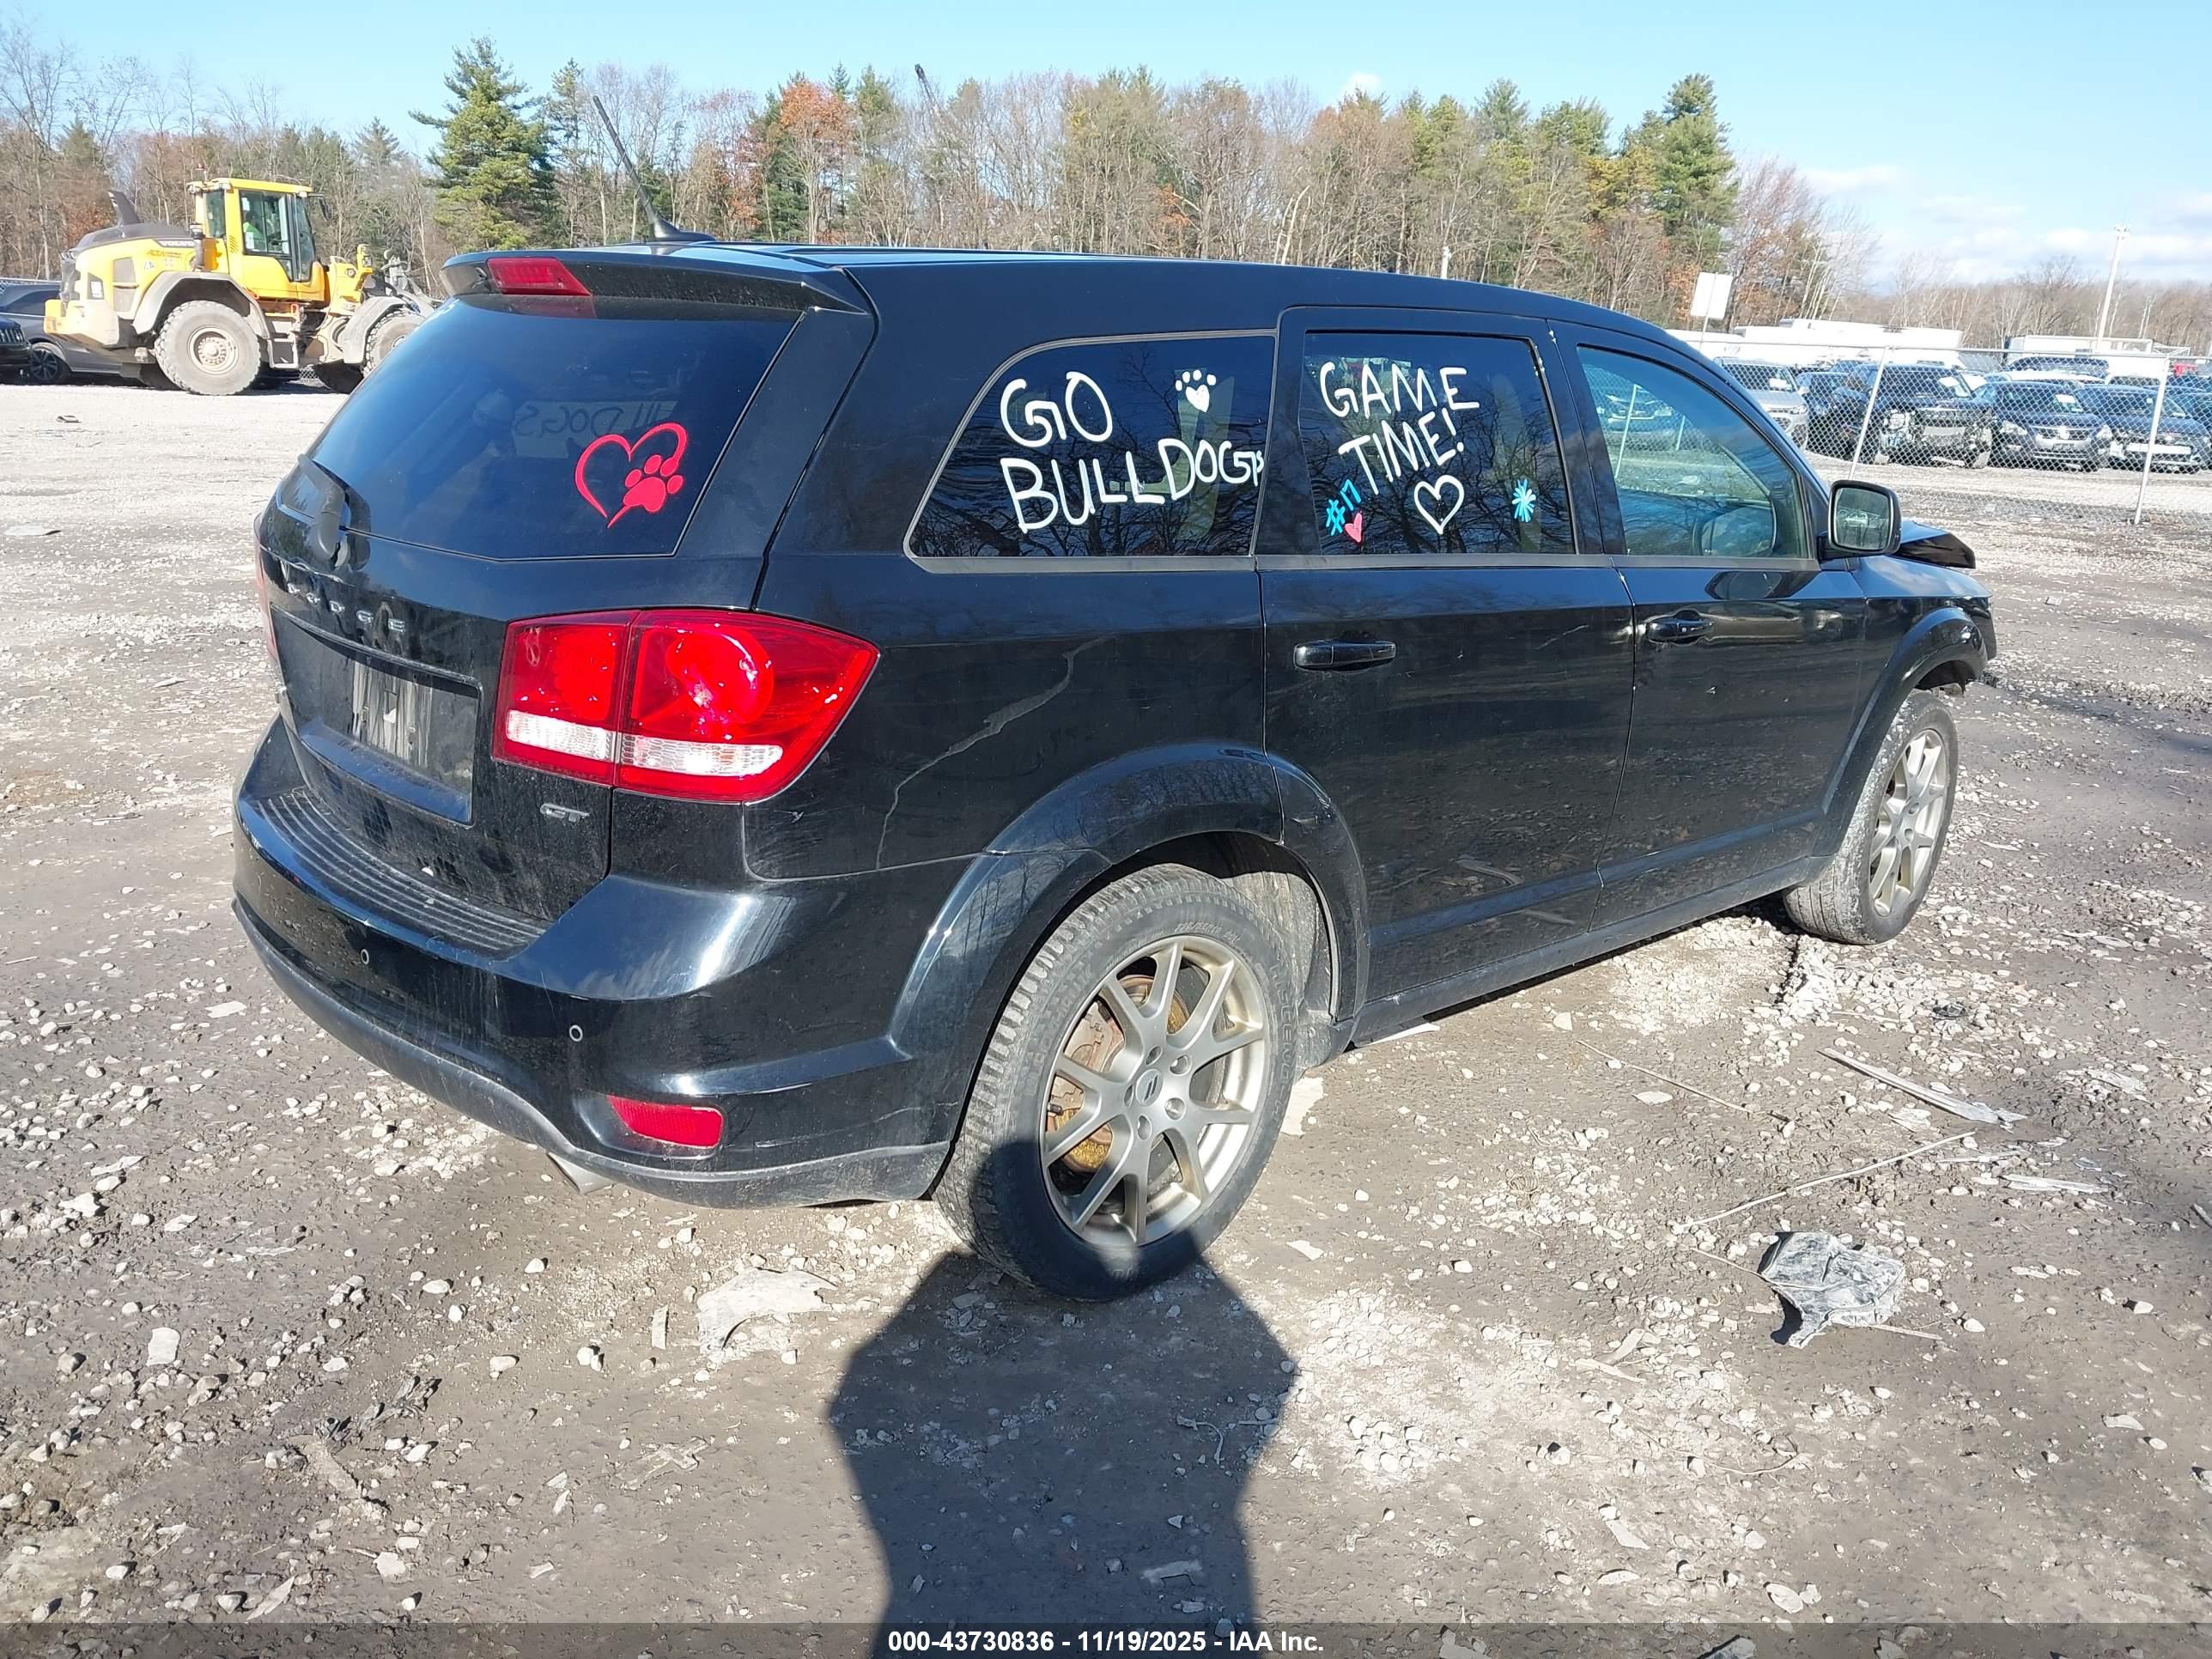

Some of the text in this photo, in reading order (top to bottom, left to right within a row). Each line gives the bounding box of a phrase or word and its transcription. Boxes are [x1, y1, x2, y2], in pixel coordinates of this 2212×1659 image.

[1000, 371, 1113, 447] GO
[1320, 362, 1480, 418] GAME
[1339, 408, 1464, 495] TIME!
[540, 803, 590, 823] GT
